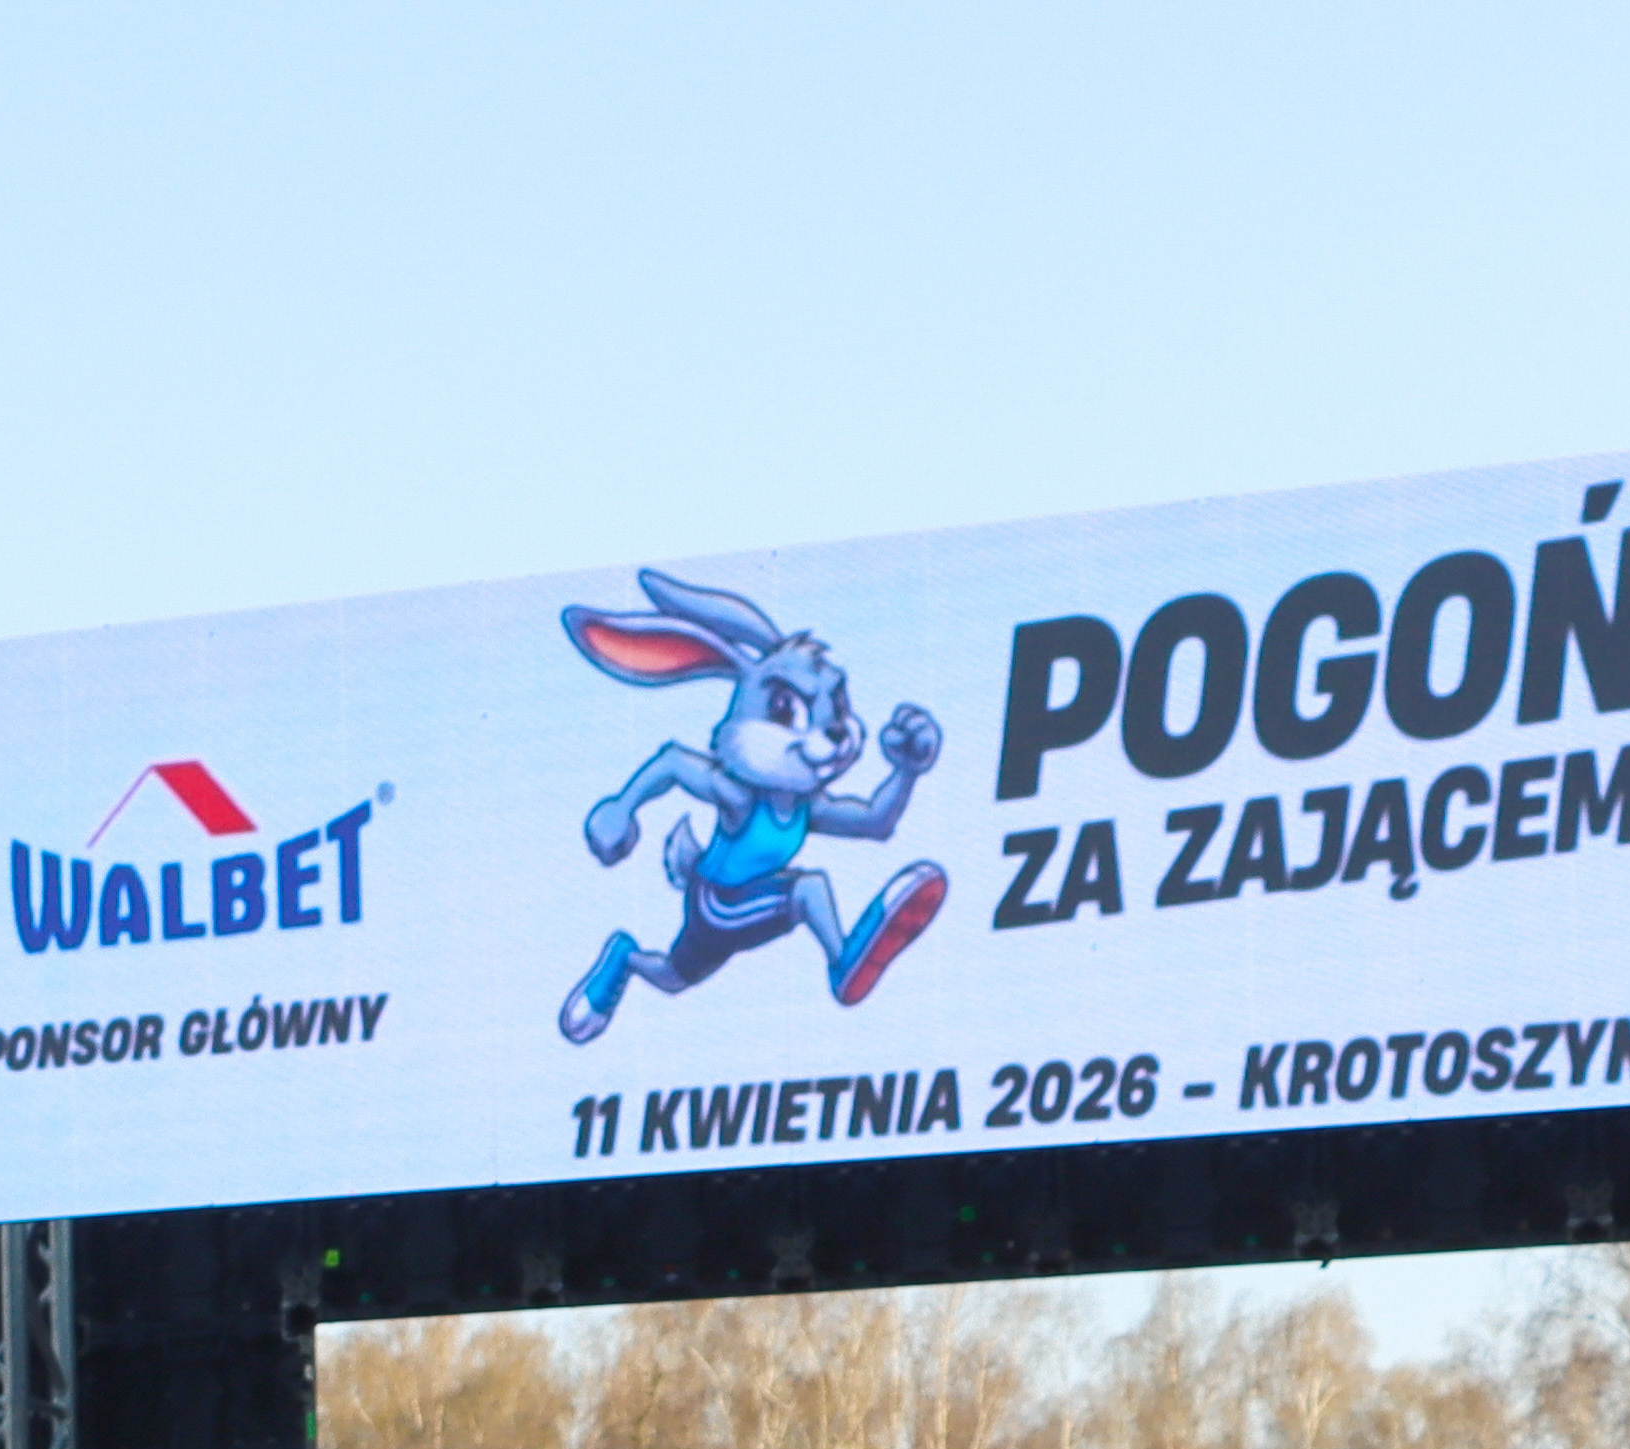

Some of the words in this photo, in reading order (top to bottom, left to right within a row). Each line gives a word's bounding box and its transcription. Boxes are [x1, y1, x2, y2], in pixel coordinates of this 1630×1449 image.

[9, 800, 376, 956] WALBET
[993, 818, 1124, 930] ZA
[178, 992, 389, 1059] GŁÓWNY
[571, 1095, 625, 1159] 11
[639, 1068, 963, 1153] KWIETNIA
[984, 1053, 1159, 1129] 2026
